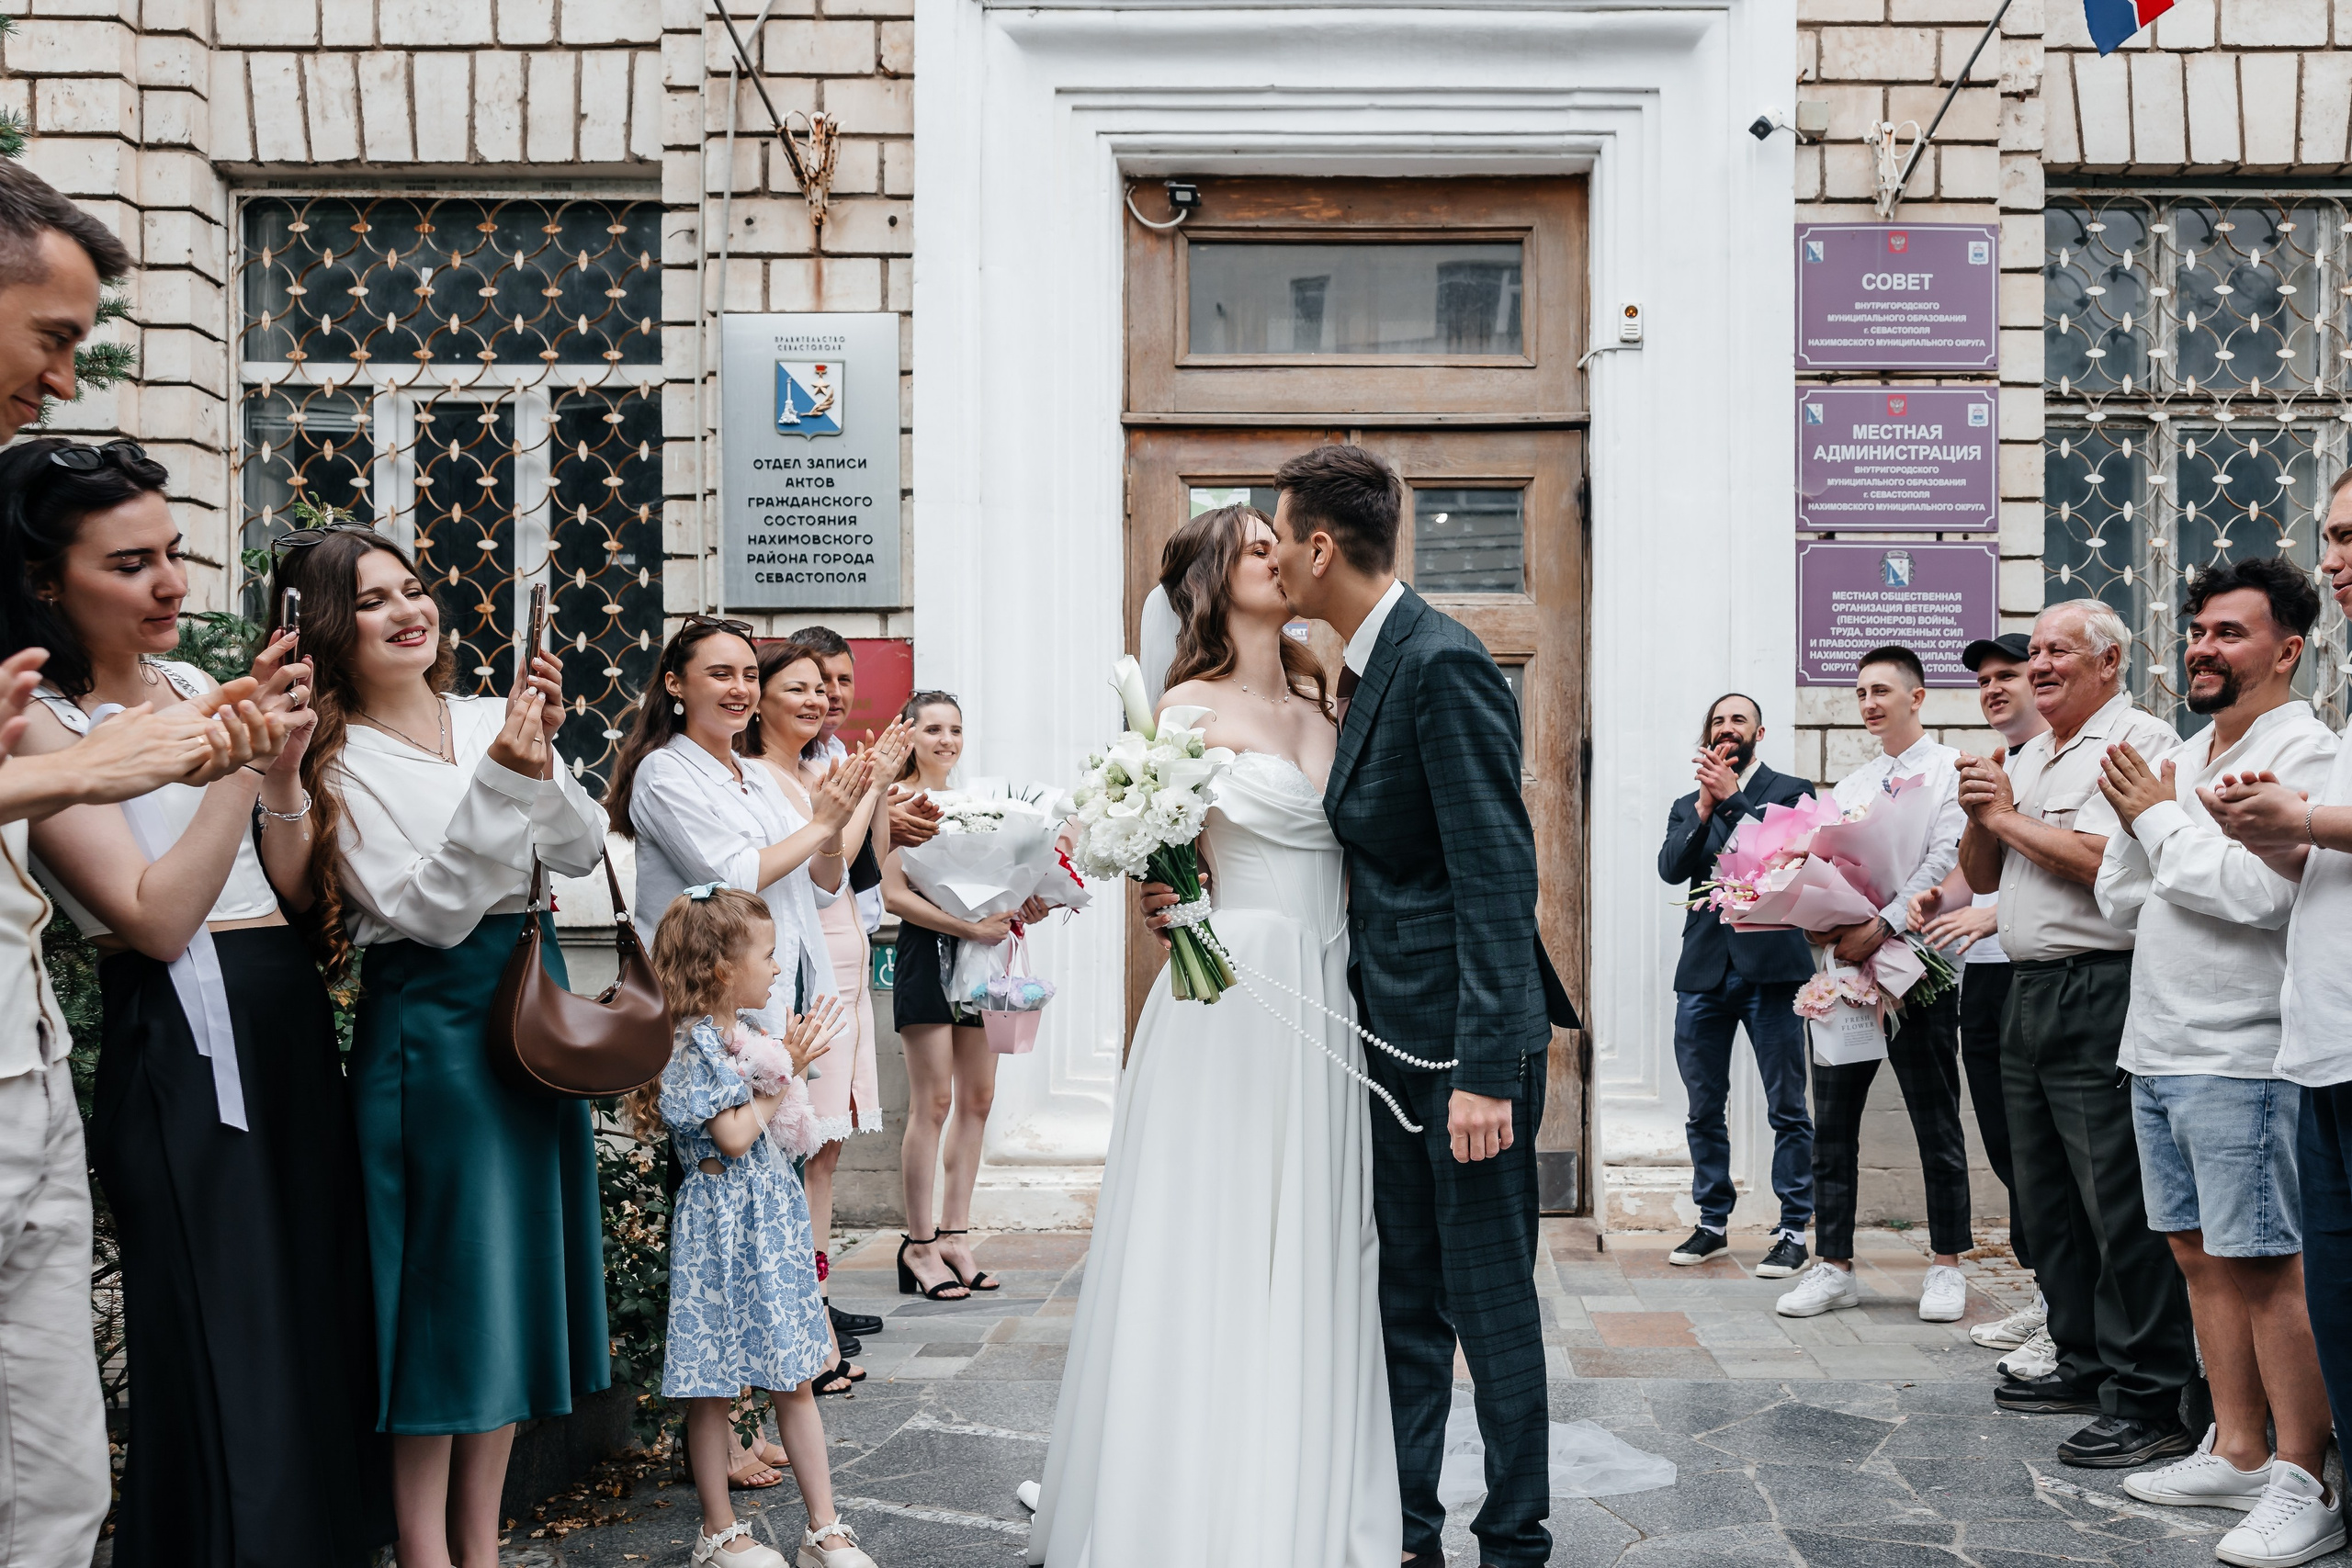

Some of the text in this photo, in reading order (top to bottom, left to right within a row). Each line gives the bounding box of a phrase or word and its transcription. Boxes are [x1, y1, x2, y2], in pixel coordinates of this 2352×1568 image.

[1861, 273, 1934, 291] СОВЕТ
[1854, 301, 1940, 311] ВНУТРИГОРОДСКОГО
[1826, 313, 1967, 323] МУНИЦИПАЛЬНОГО ОБРАЗОВАНИЯ
[1870, 326, 1931, 335] СЕВАСТОПОЛЯ
[1807, 338, 1986, 348] НАХИМОВСКОГО МУНИЦИПАЛЬНОГО ОКРУГА
[1852, 423, 1943, 440] МЕСТНАЯ
[1813, 445, 1982, 463] АДМИНИСТРАЦИЯ
[752, 457, 867, 470] ОТДЕЛ ЗАПИСИ
[1854, 466, 1940, 475] ВНУТРИГОРОДСКОГО
[785, 477, 835, 489] АКТОВ
[1826, 478, 1967, 487] МУНИЦИПАЛЬНОГО ОБРАЗОВАНИЯ
[1870, 491, 1930, 499] СЕВАСТОПОЛЯ
[747, 496, 873, 508] ГРАЖДАНСКОГО
[1807, 502, 1986, 513] НАХИМОВСКОГО МУНИЦИПАЛЬНОГО ОКРУГА
[763, 514, 857, 526] СОСТОЯНИЯ
[747, 534, 874, 546] НАХИМОВСКОГО
[747, 550, 875, 565] РАЙОНА ГОРОДА
[754, 571, 866, 583] СЕВАСТОПОЛЯ
[1832, 591, 1962, 603] МЕСТНАЯ ОБЩЕСТВЕННАЯ
[1831, 603, 1962, 615] ОРГАНИЗАЦИЯ ВЕТЕРАНОВ
[1837, 615, 1957, 626] (ПЕНСИОНЕРОВ) ВОЙНЫ,
[1830, 627, 1964, 637] ТРУДА, ВООРУЖЕННЫХ СИЛ
[1809, 638, 1974, 649] И ПРАВООХРАНИТЕЛЬНЫХ ОРГАН
[1809, 651, 1867, 660] НАХИМОВС
[1821, 662, 1858, 672] ОКРУГА
[1844, 1015, 1870, 1023] FRESH
[1841, 1021, 1875, 1031] FLOWER
[2289, 1471, 2307, 1483] adidas
